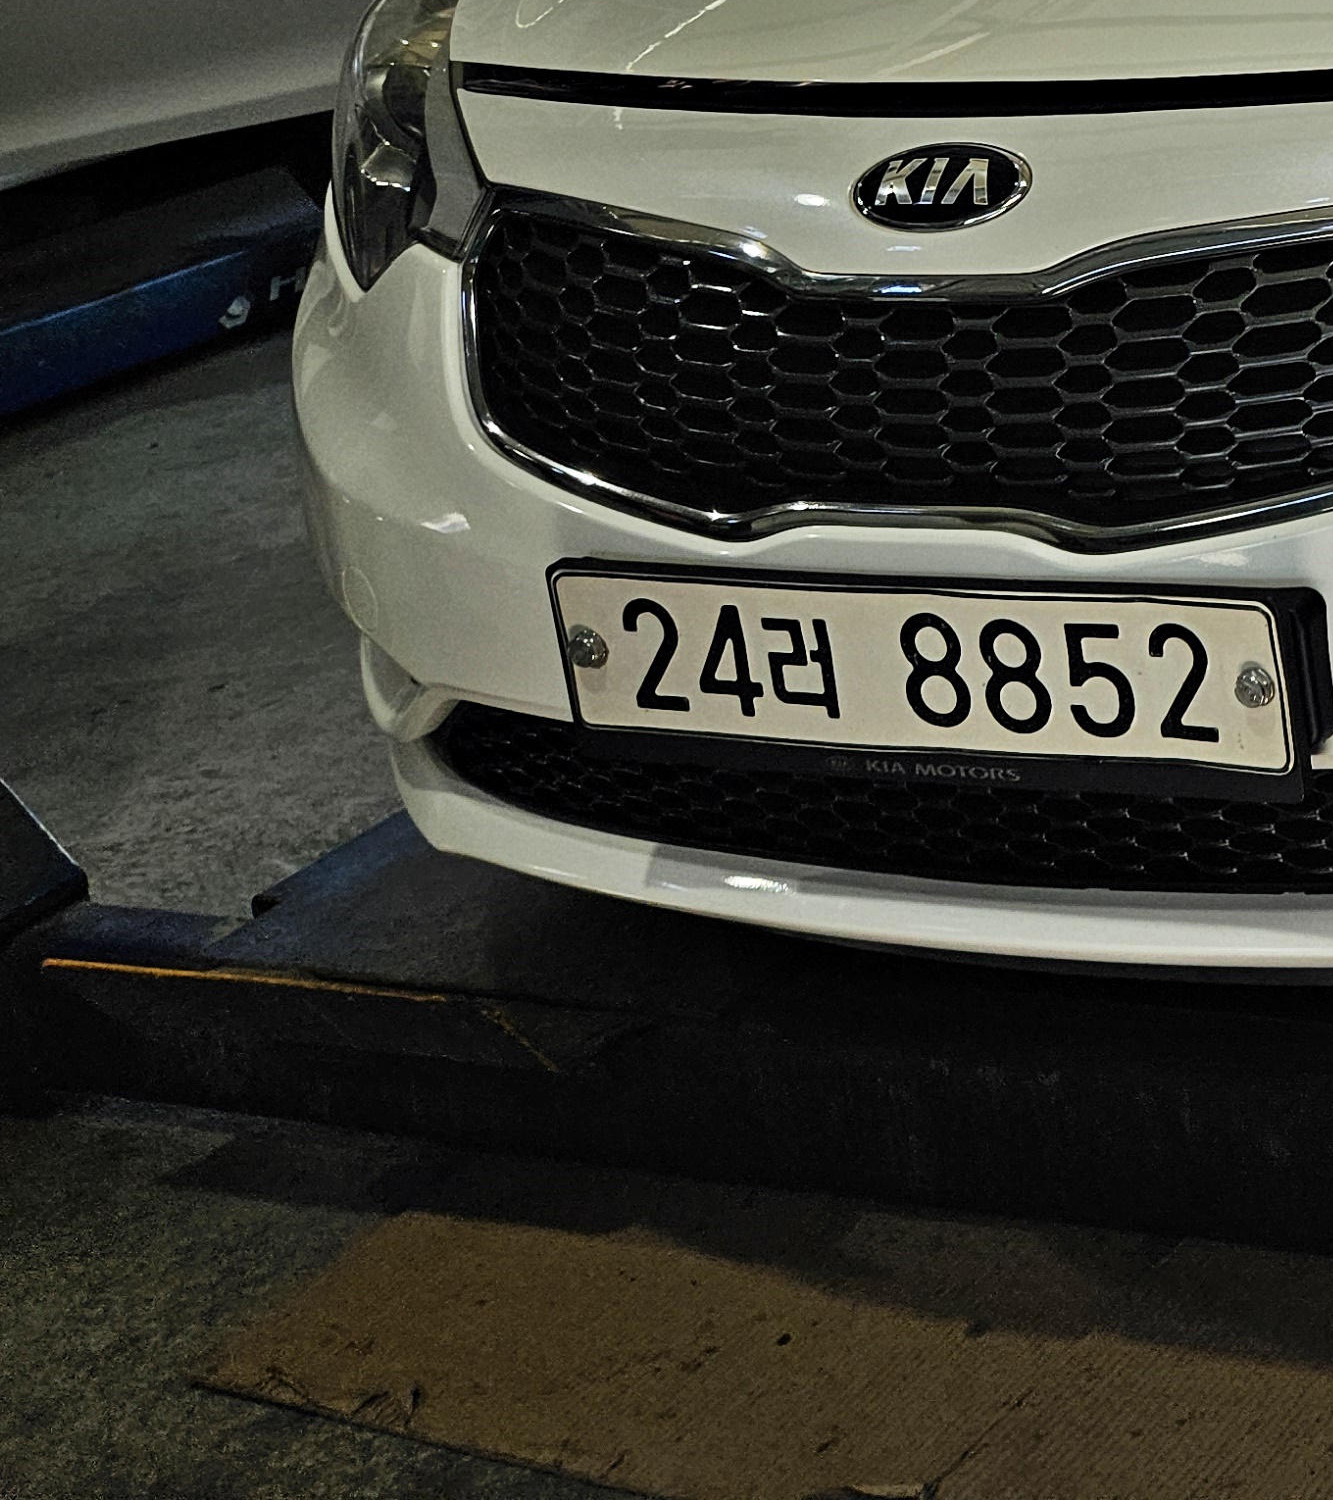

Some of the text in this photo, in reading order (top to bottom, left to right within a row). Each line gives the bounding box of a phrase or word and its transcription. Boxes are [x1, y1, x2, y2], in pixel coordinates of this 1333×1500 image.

[874, 157, 989, 206] KIA
[621, 597, 1220, 743] 24러 8852
[864, 758, 907, 776] KIA
[914, 762, 1022, 783] MOTORS
